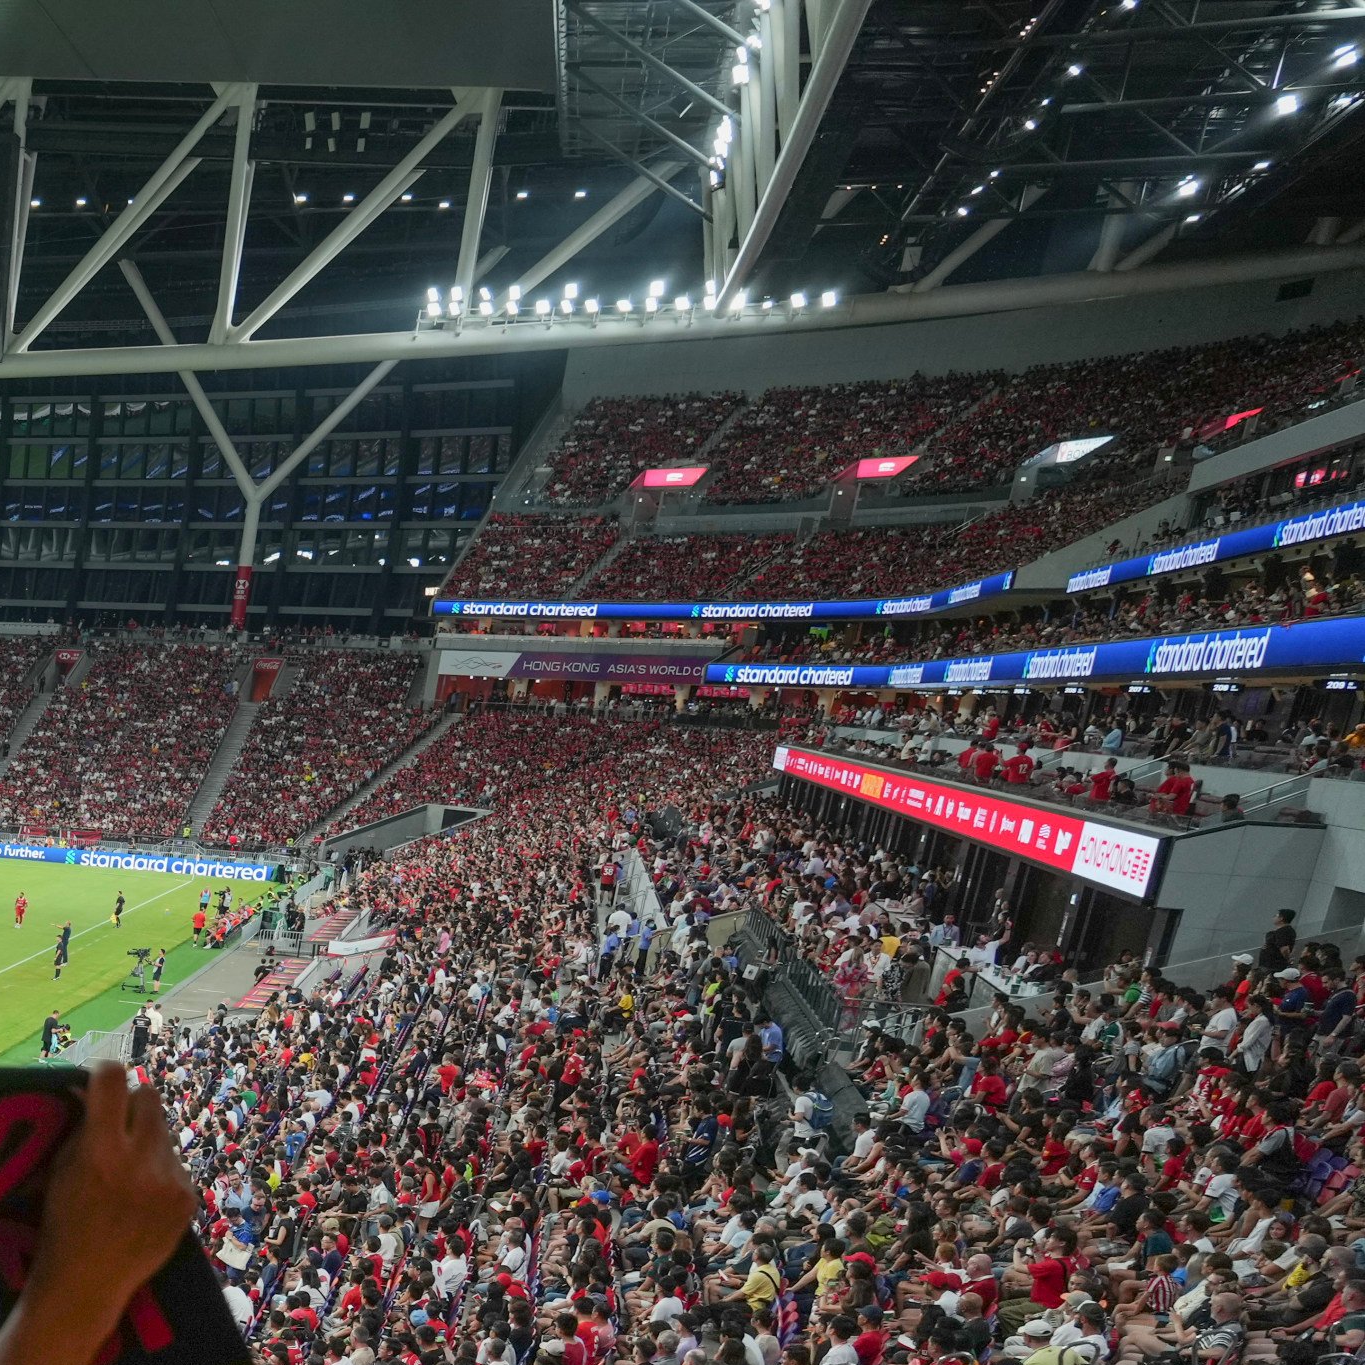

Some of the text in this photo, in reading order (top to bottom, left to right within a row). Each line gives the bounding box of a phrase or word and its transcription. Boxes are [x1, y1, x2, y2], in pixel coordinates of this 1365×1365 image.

[463, 602, 597, 616] standard chartered
[701, 603, 813, 618] standard chartered
[1151, 627, 1270, 672] standard chartered
[523, 660, 561, 674] HONG
[561, 660, 600, 674] KONG
[607, 663, 647, 675] ASIA'S
[649, 664, 691, 676] WORLD
[737, 665, 853, 685] standard chartered
[4, 846, 45, 860] further.
[80, 849, 267, 882] standard chartered
